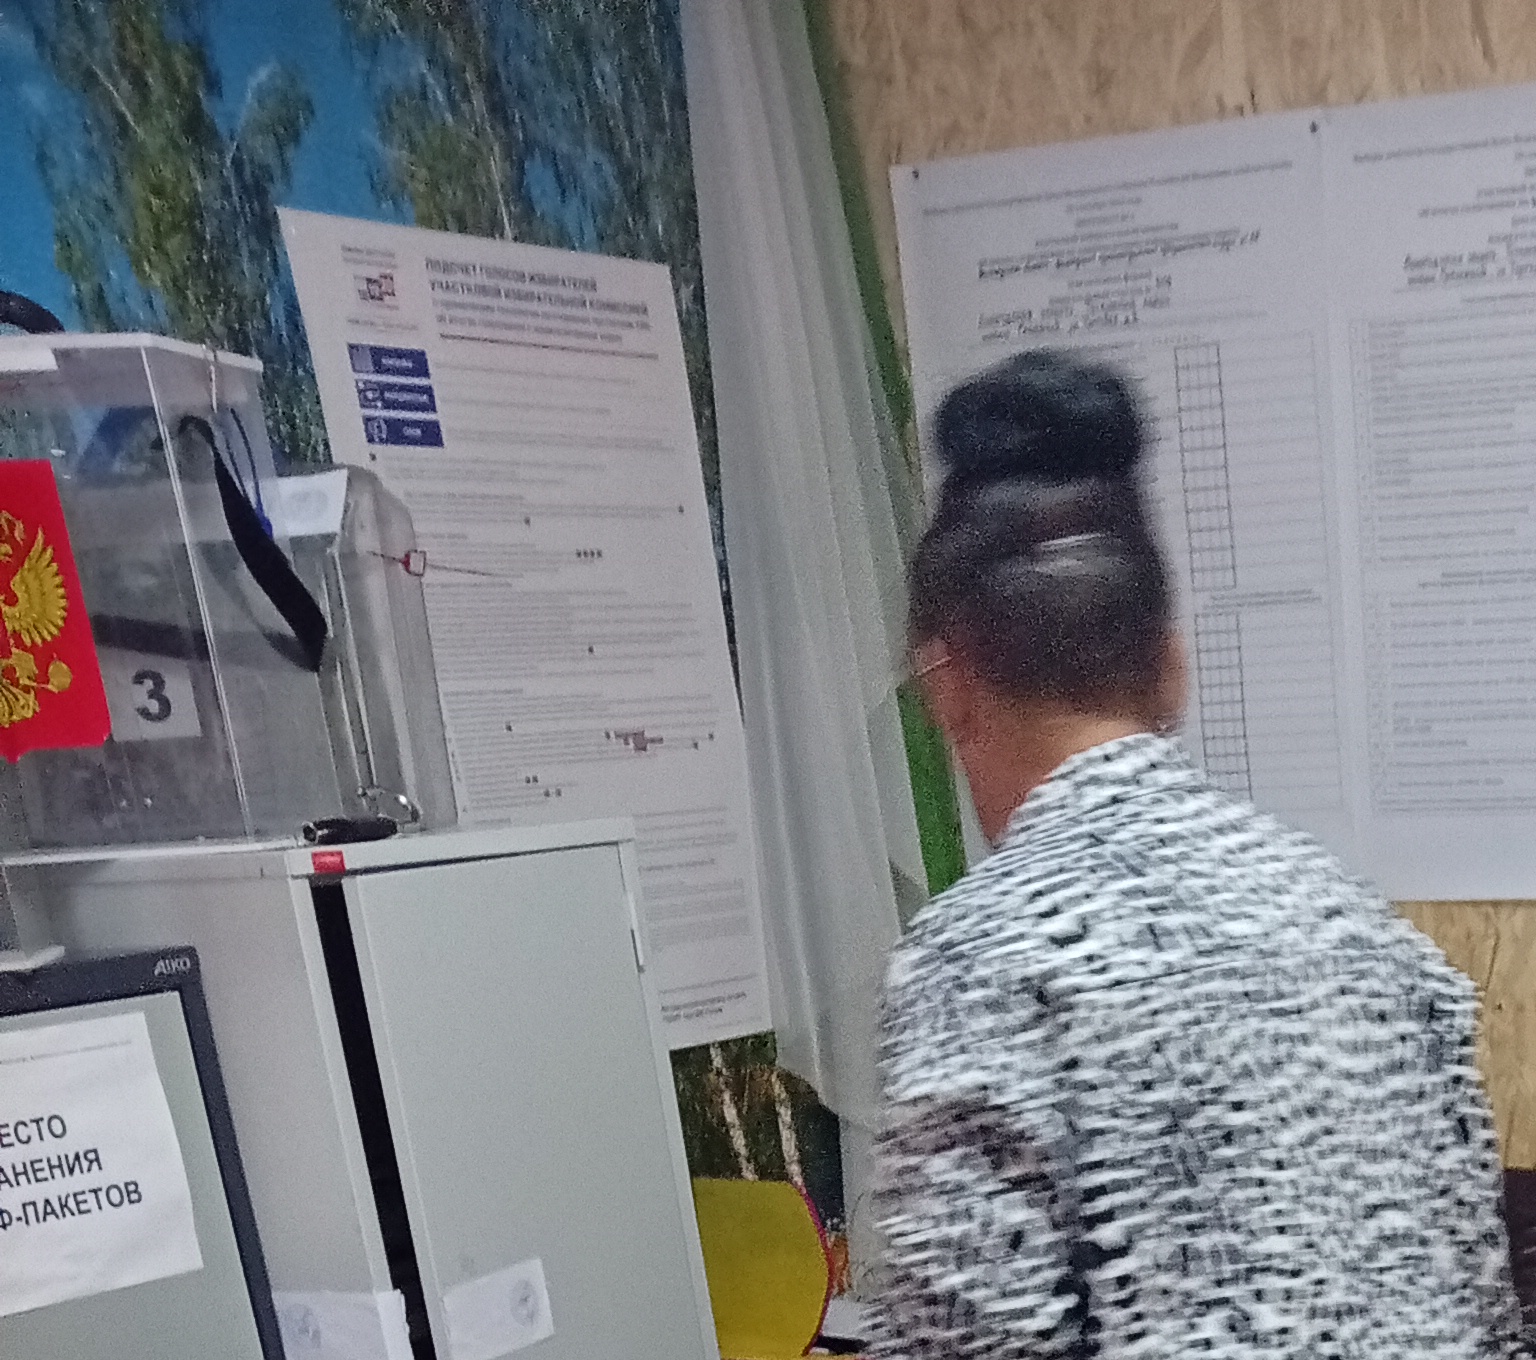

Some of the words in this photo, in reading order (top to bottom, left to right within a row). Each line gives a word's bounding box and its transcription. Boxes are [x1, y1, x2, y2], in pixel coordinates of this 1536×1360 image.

[132, 669, 172, 722] 3
[0, 1114, 67, 1149] ЕСТО
[0, 1148, 103, 1191] АНЕНИЯ
[0, 1180, 143, 1230] Ф-ПАКЕТОВ
